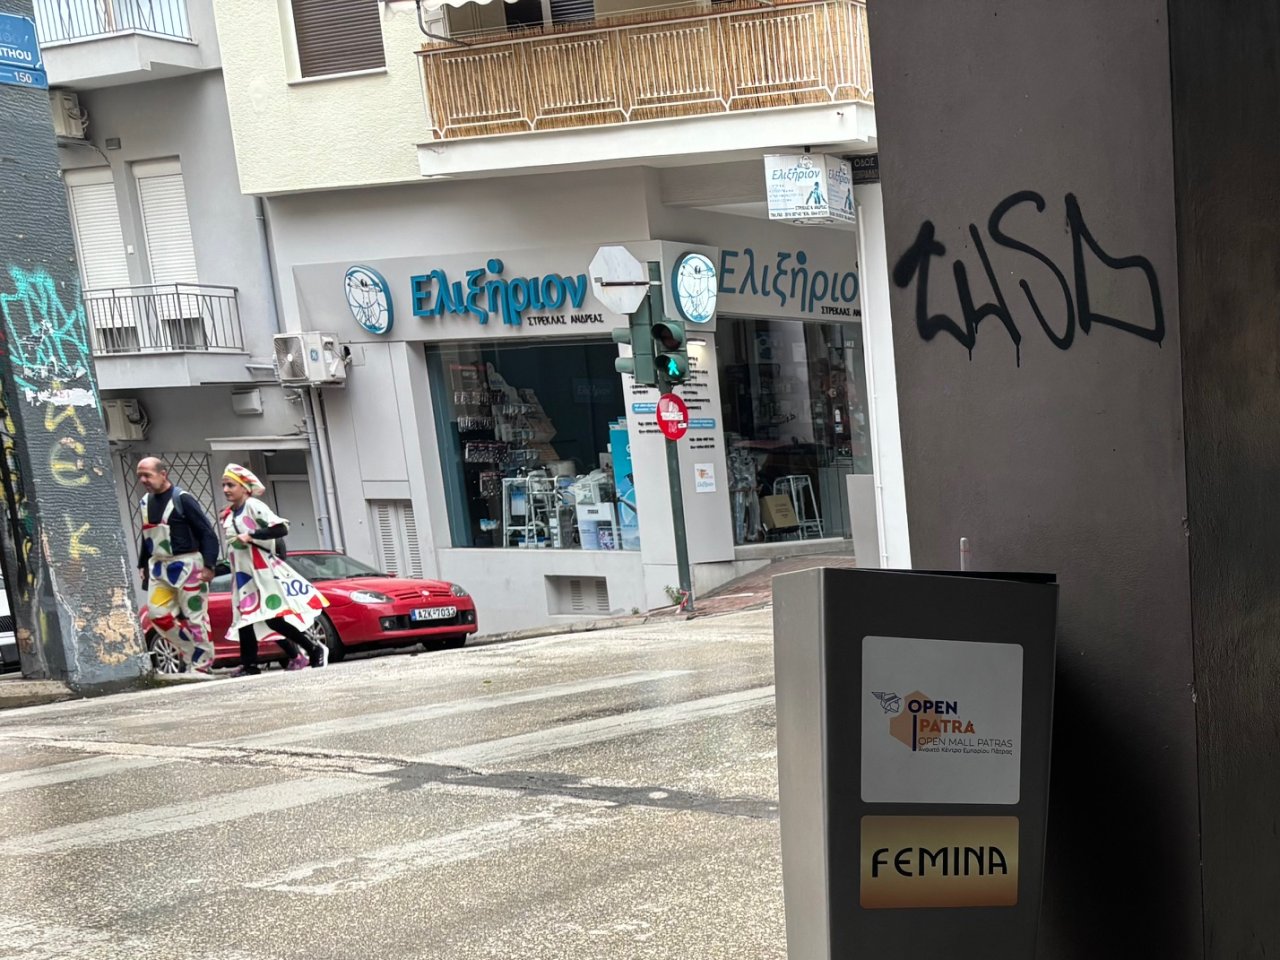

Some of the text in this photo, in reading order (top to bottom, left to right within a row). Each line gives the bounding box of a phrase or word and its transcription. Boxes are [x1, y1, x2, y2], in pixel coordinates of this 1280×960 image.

[14, 72, 33, 84] 150
[410, 258, 588, 328] Ελιξήριον
[527, 313, 604, 326] ΣΤΡΕΚΛΑΣ ΑΝΔΡΕΑΣ
[908, 699, 958, 715] OPEN
[919, 718, 976, 734] PATRA
[918, 736, 1013, 748] OPEN MALL PATRAS
[871, 846, 1008, 878] FEMINA
